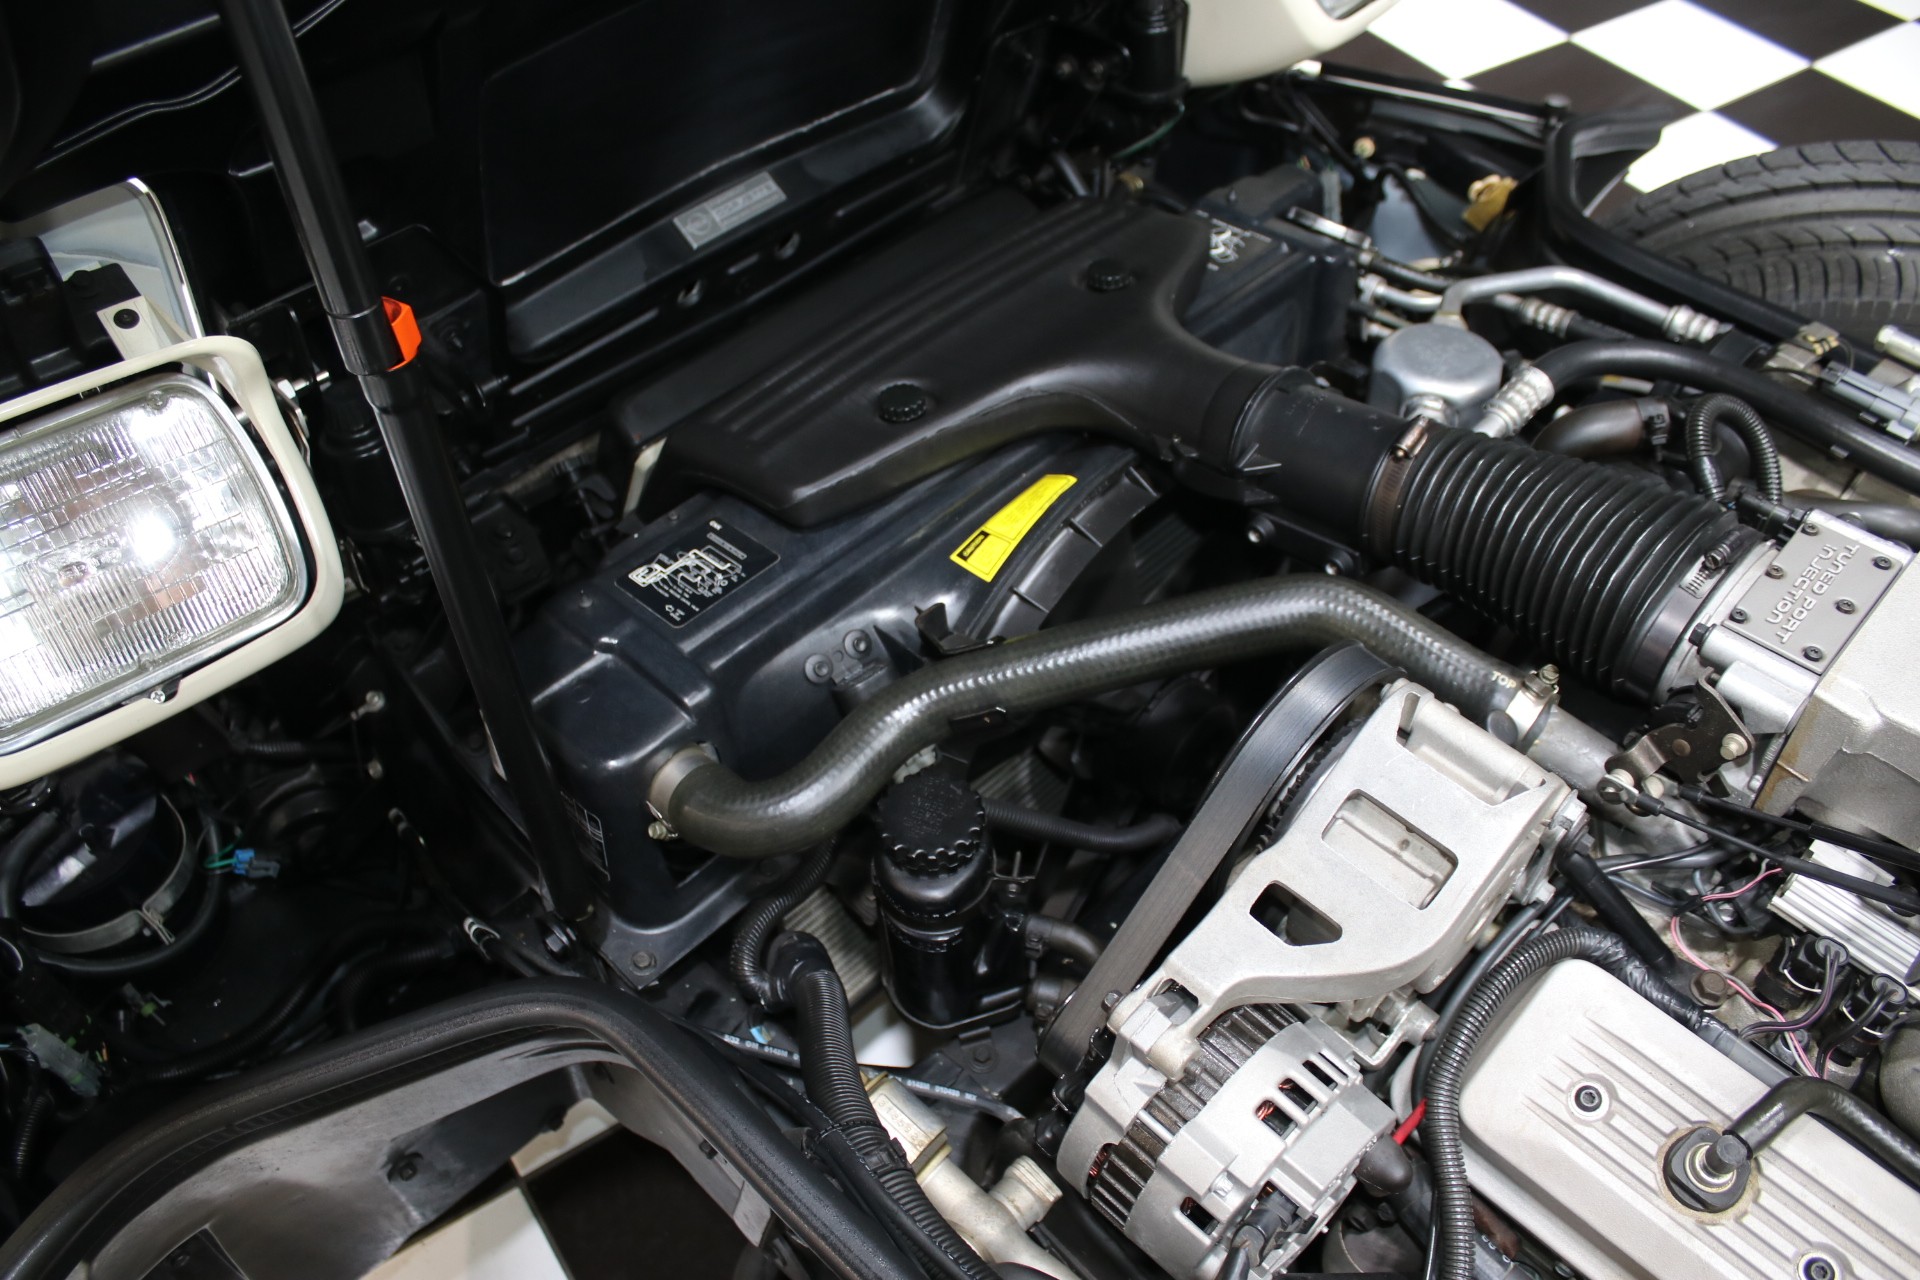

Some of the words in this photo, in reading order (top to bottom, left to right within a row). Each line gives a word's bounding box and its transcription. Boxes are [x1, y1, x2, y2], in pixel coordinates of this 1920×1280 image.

[1764, 543, 1838, 625] INJECTION
[1811, 543, 1860, 596] TUNED
[1775, 595, 1817, 645] PORT
[1491, 670, 1517, 689] TOP
